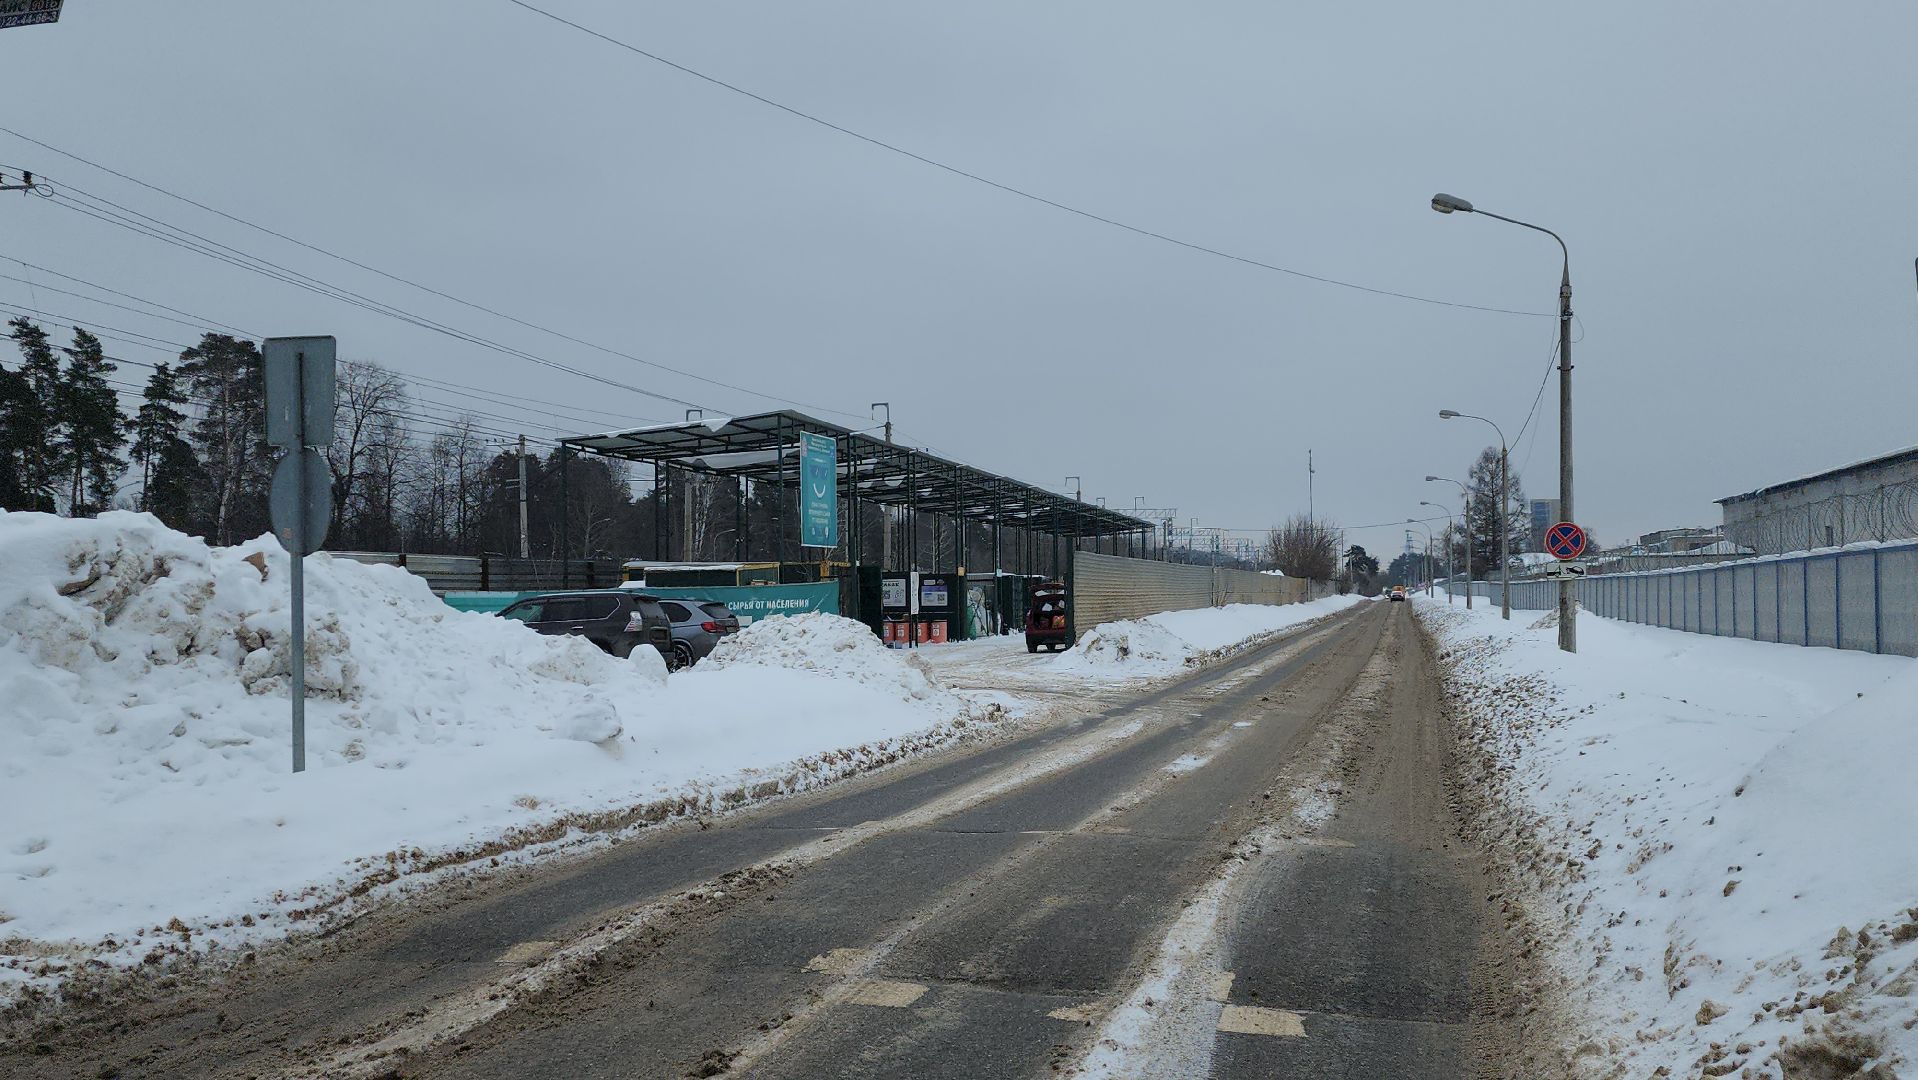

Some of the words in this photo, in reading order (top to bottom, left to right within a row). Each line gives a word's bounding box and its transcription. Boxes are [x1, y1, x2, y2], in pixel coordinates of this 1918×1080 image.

[728, 601, 754, 610] СЫРЬЯ
[755, 600, 765, 609] ОТ
[766, 599, 809, 609] НАСЕЛЕНИЯ
